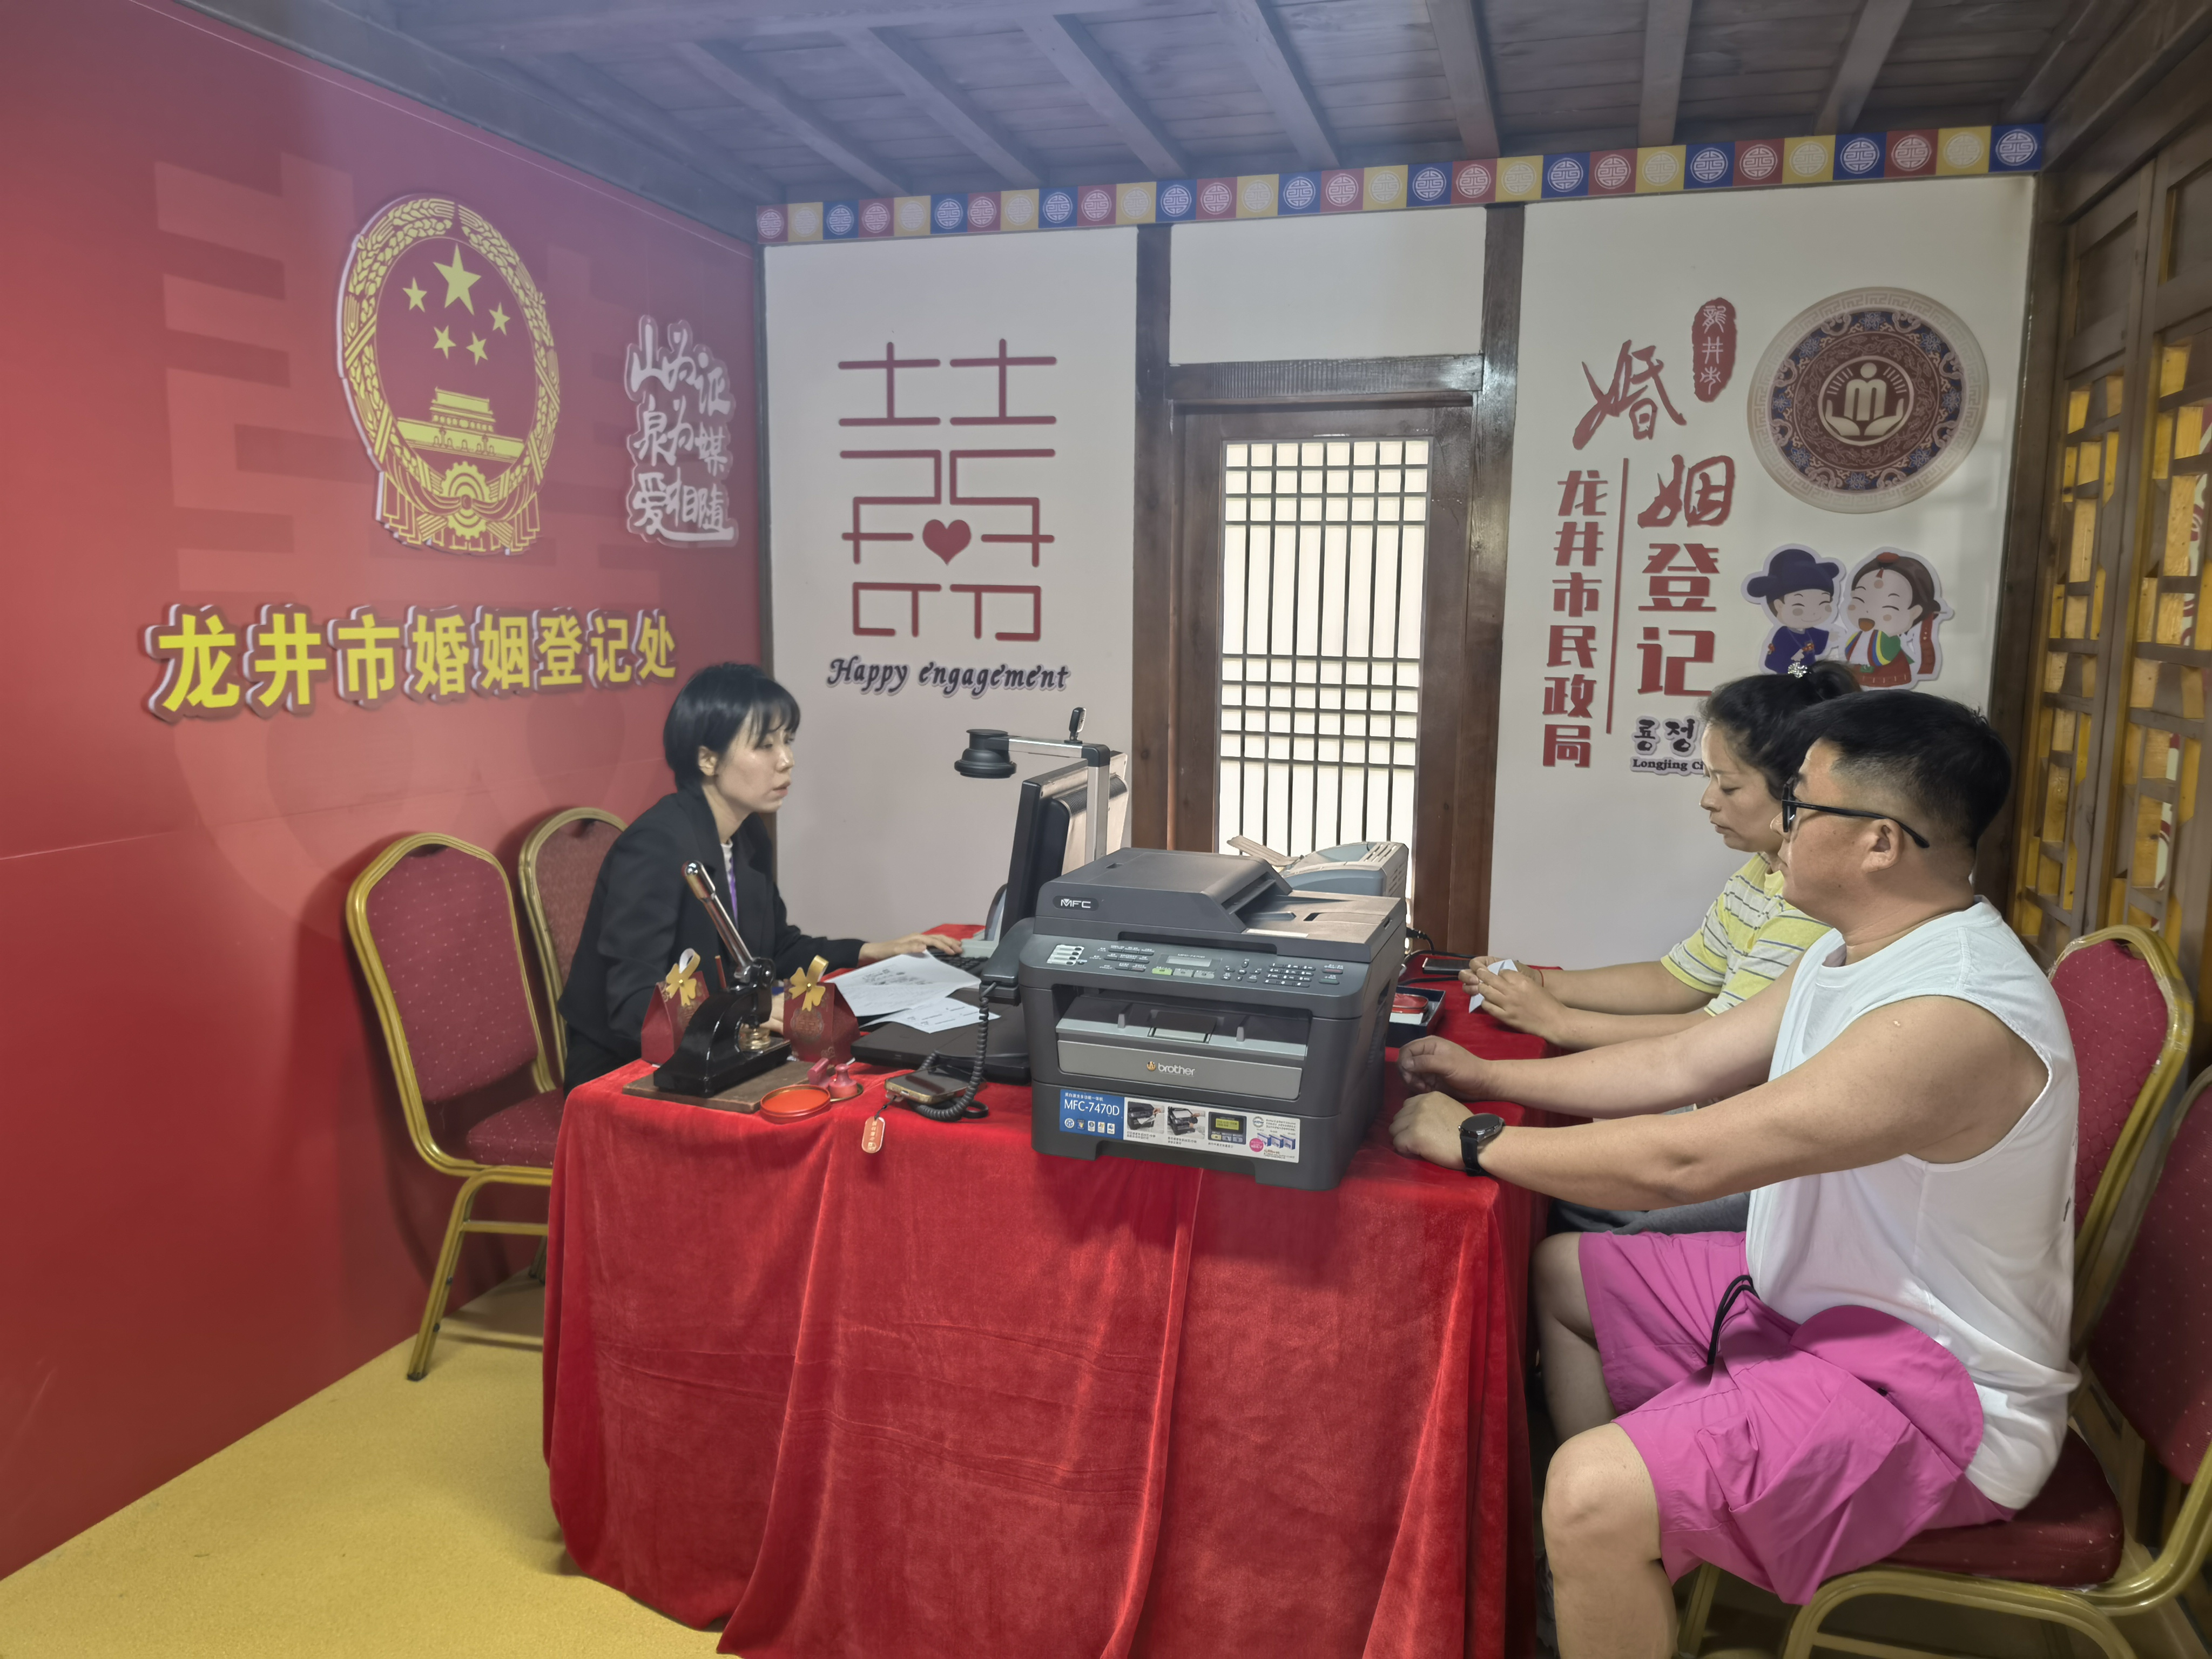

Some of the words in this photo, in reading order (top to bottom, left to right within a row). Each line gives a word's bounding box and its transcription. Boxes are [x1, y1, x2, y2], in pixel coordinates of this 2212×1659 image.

[1573, 339, 1735, 697] 婚姻登记
[1542, 470, 1609, 768] 龙井市民政局
[158, 612, 677, 713] 龙井市婚姻登记处
[827, 655, 908, 693] Happy
[918, 662, 1069, 697] engagement
[1634, 718, 1696, 753] 룡정
[1632, 758, 1688, 772] Longjing
[1691, 760, 1704, 770] Ci
[1060, 898, 1091, 908] MFC
[1157, 1062, 1196, 1076] brother
[1064, 1098, 1120, 1116] MFC-7470D
